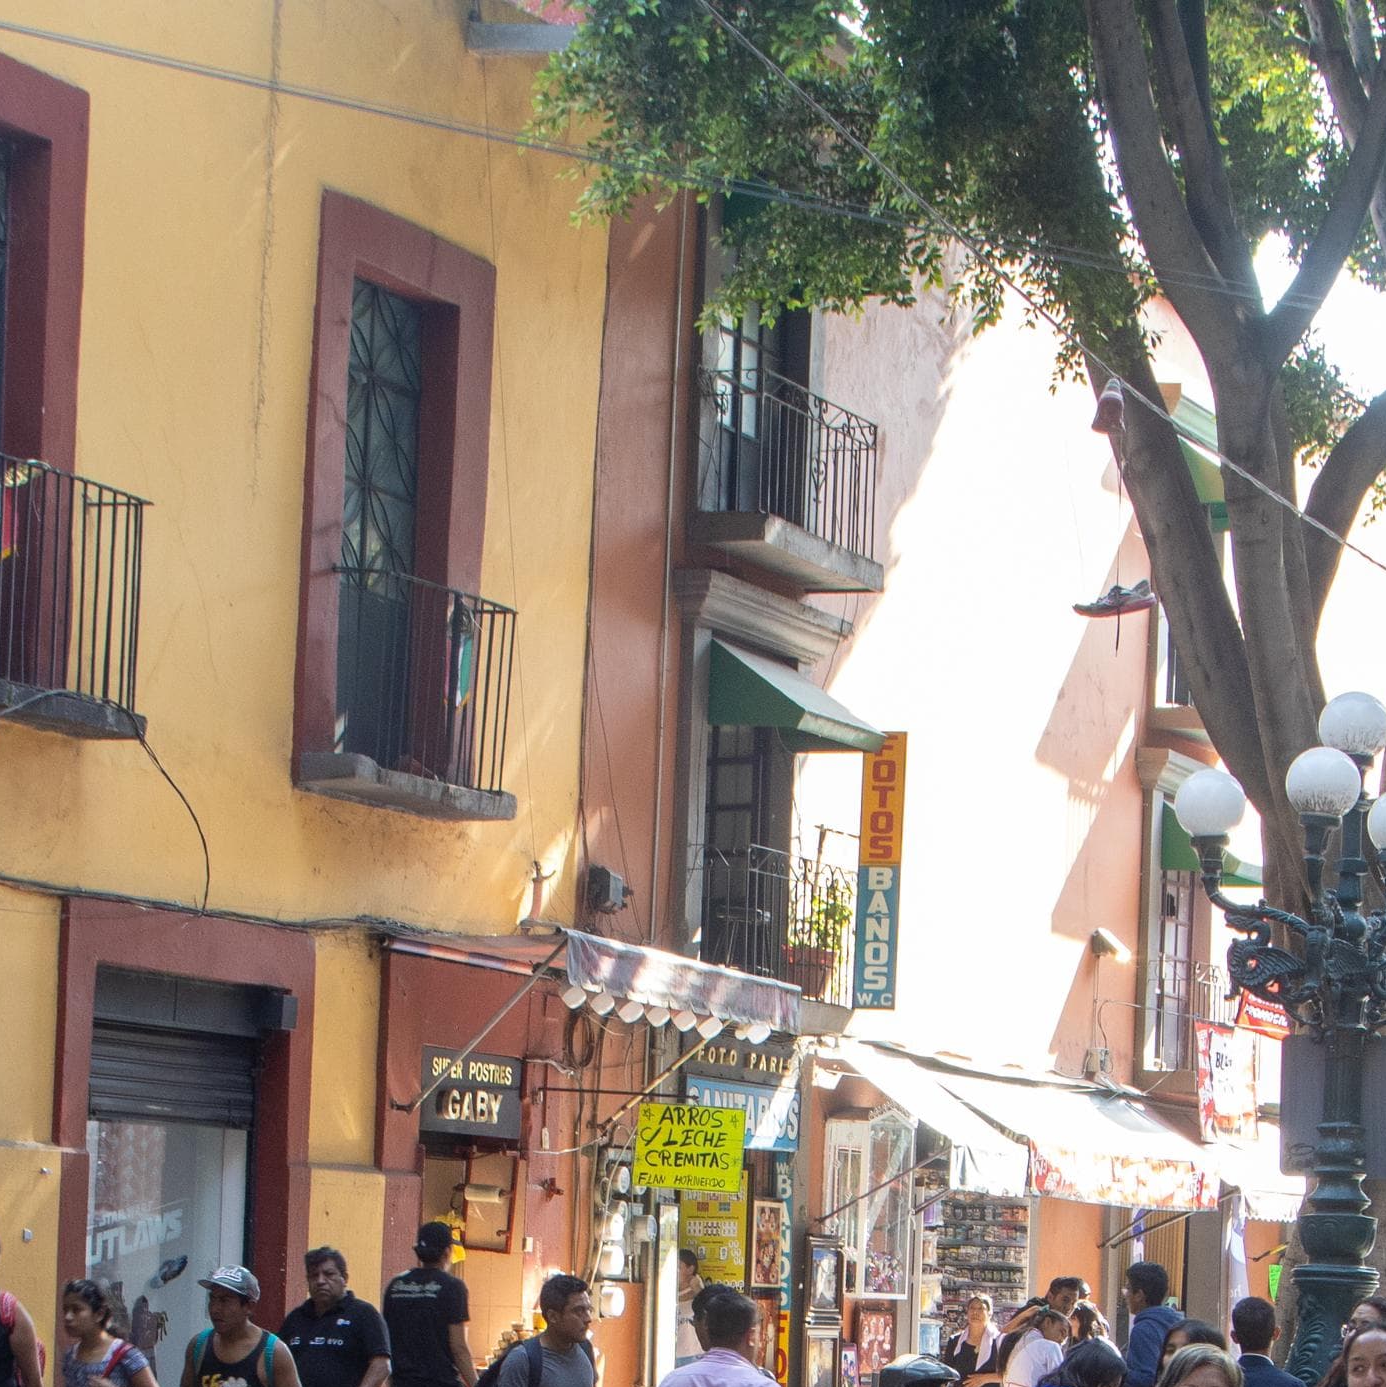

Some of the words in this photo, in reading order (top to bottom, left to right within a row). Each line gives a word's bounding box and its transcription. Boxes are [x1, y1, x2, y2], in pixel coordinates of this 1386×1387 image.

[868, 733, 899, 860] FOTOS
[469, 1060, 514, 1086] POSTRES
[696, 1046, 738, 1067] FOTO
[749, 1052, 791, 1075] PARI
[445, 1088, 503, 1124] GABY
[658, 1105, 724, 1129] ARROS
[662, 1129, 728, 1148] LECHE
[644, 1149, 730, 1170] CREMITAS
[638, 1172, 666, 1185] FLAN
